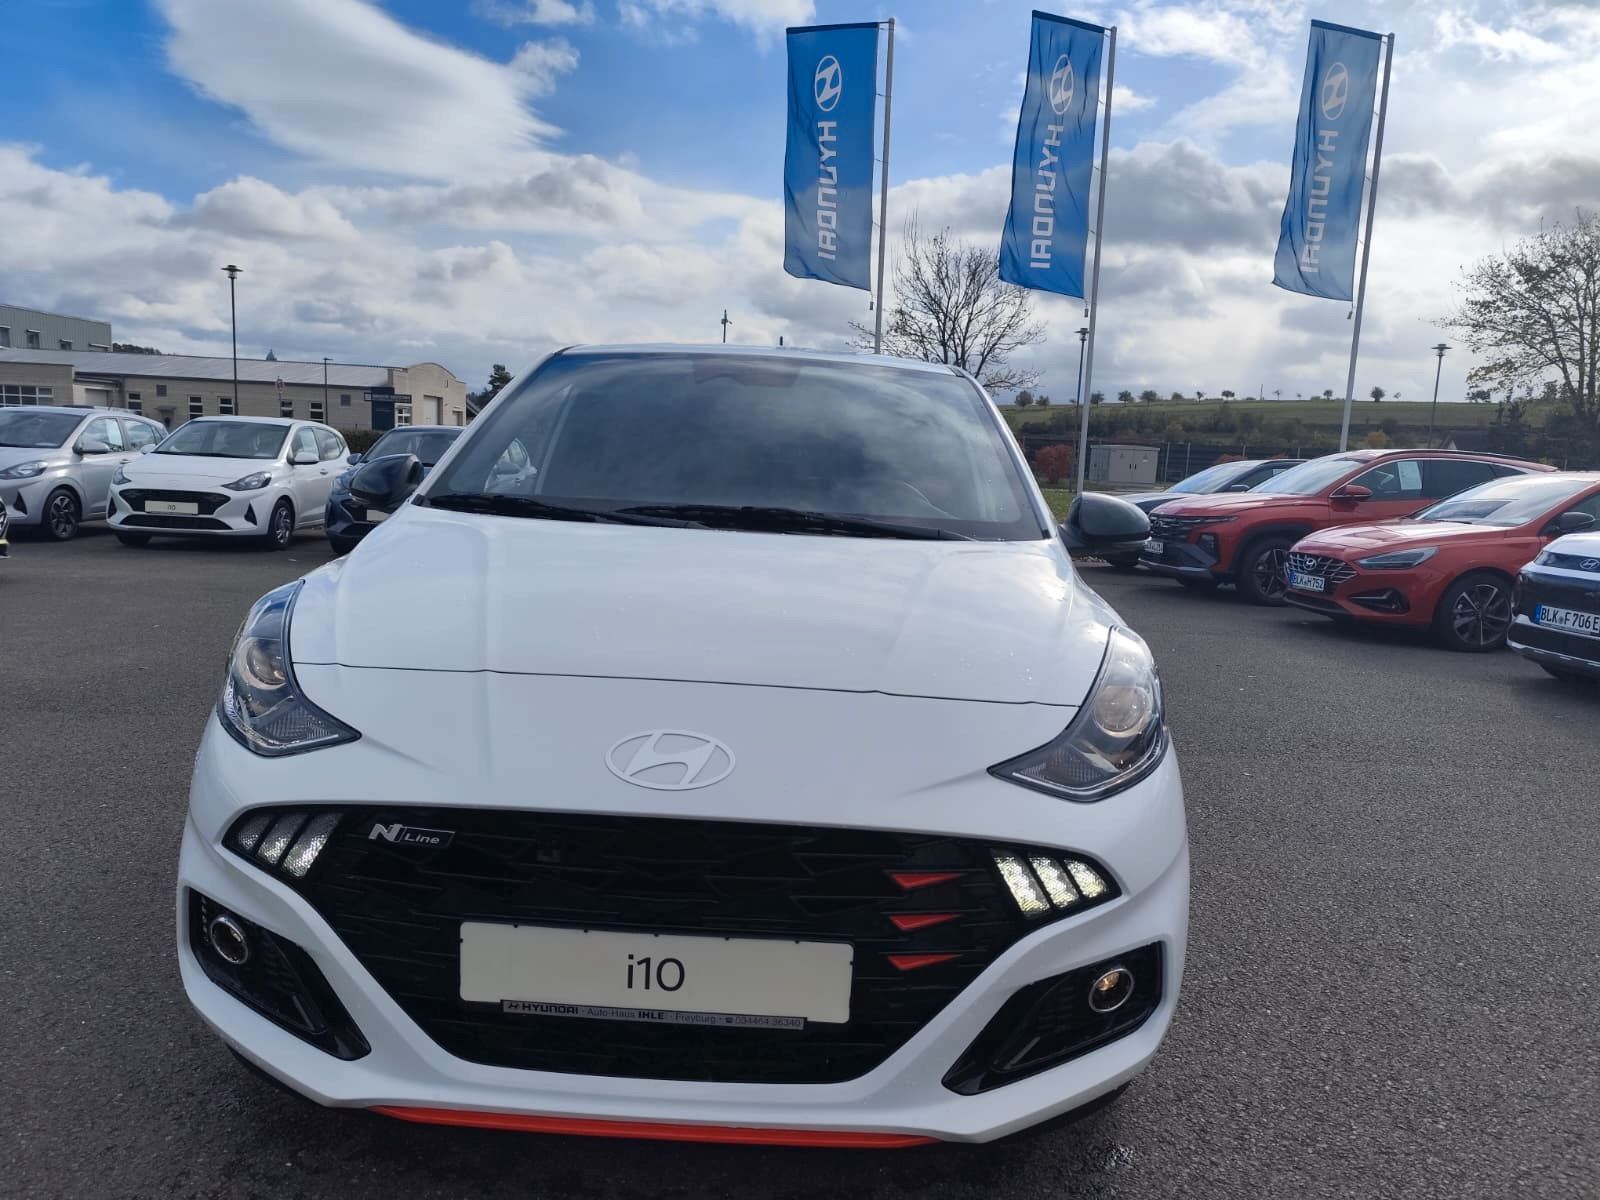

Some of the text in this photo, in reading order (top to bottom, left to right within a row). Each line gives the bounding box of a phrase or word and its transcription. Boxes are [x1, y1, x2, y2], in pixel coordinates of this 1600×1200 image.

[368, 823, 440, 844] N Line
[626, 953, 686, 992] i10
[521, 1003, 579, 1015] HYUNDAI
[638, 1010, 665, 1020] IHLE
[675, 1012, 717, 1025] Freyburg
